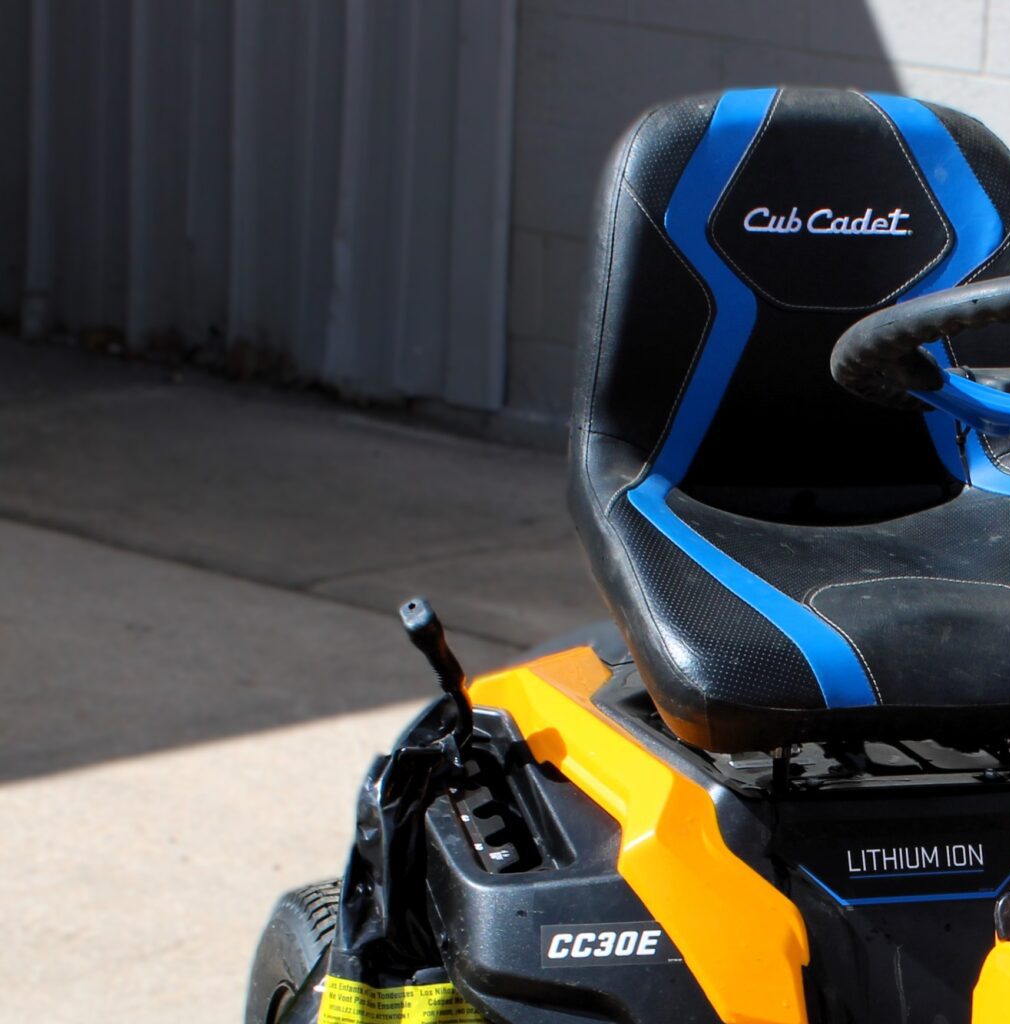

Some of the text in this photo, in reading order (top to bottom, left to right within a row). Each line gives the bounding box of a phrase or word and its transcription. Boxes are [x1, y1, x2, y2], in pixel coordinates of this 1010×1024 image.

[743, 206, 910, 236] Cub Cadet
[847, 844, 984, 872] LITHIUM ION
[548, 930, 662, 959] CC30E
